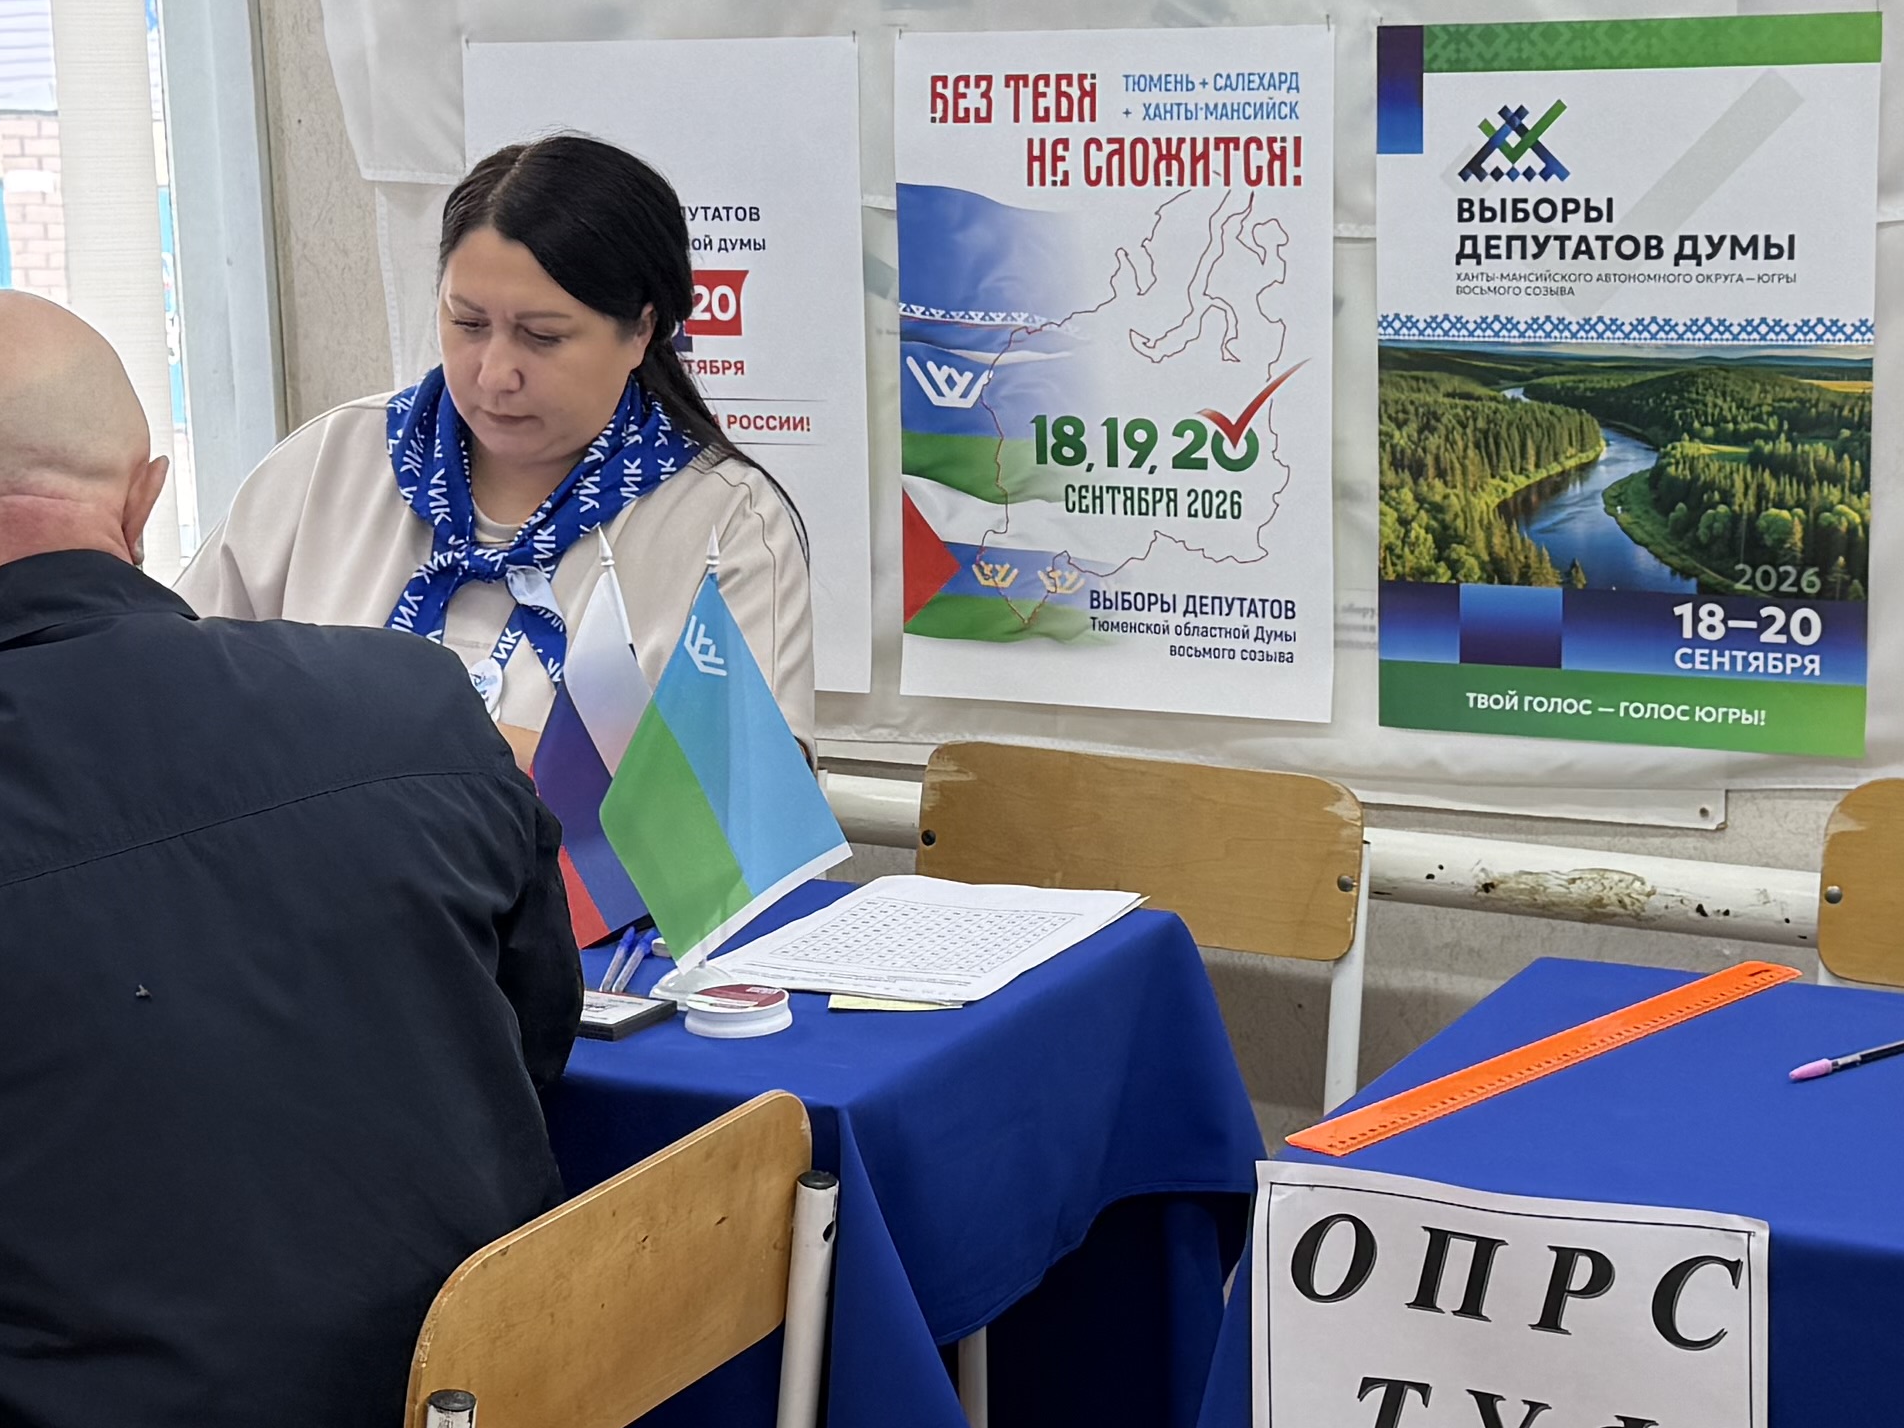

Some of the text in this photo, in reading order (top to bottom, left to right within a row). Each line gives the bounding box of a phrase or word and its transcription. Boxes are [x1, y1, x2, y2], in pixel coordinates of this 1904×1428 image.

[1123, 74, 1195, 92] ТЮМЕНЬ
[1213, 72, 1300, 94] САЛЕХАРД
[930, 72, 1097, 124] БЕЗ ТЕБЯ
[1142, 97, 1299, 121] ХАНТЫ-МАНСИЙСК
[1026, 135, 1303, 187] НЕ СЛОЖИТСЯ!
[682, 206, 761, 222] УТАТОВ
[1457, 197, 1614, 224] ВЫБОРЫ
[717, 238, 766, 253] ДУМЫ
[1455, 234, 1795, 266] ДЕПУТАТОВ ДУМЫ
[1456, 270, 1593, 283] ХАНТЫ-МАНСИЙСКОГО
[1596, 273, 1692, 283] АВТОНОМНОГО
[1456, 285, 1575, 296] ВОСЬМОГО СОЗЫВА
[691, 285, 737, 321] 20
[686, 360, 745, 375] ТЯБРЯ
[727, 415, 811, 432] РОССИИ!
[1064, 483, 1242, 520] СЕНТЯБРЯ 2026
[1735, 564, 1822, 594] 2026
[1089, 590, 1296, 620] ВЫБОРЫ ДЕПУТАТОВ
[493, 628, 522, 662] ИК
[1089, 617, 1296, 645] Тюменской областной Думы
[1169, 645, 1294, 664] восьмого созыва
[1674, 647, 1821, 676] СЕНТЯБРЯ
[1466, 689, 1519, 711] ТВОЙ
[1523, 696, 1592, 716] ГОЛОС
[1619, 702, 1690, 722] ГОЛОС
[1695, 706, 1766, 726] ЮГРЫ!
[1290, 1212, 1744, 1351] О П Р С
